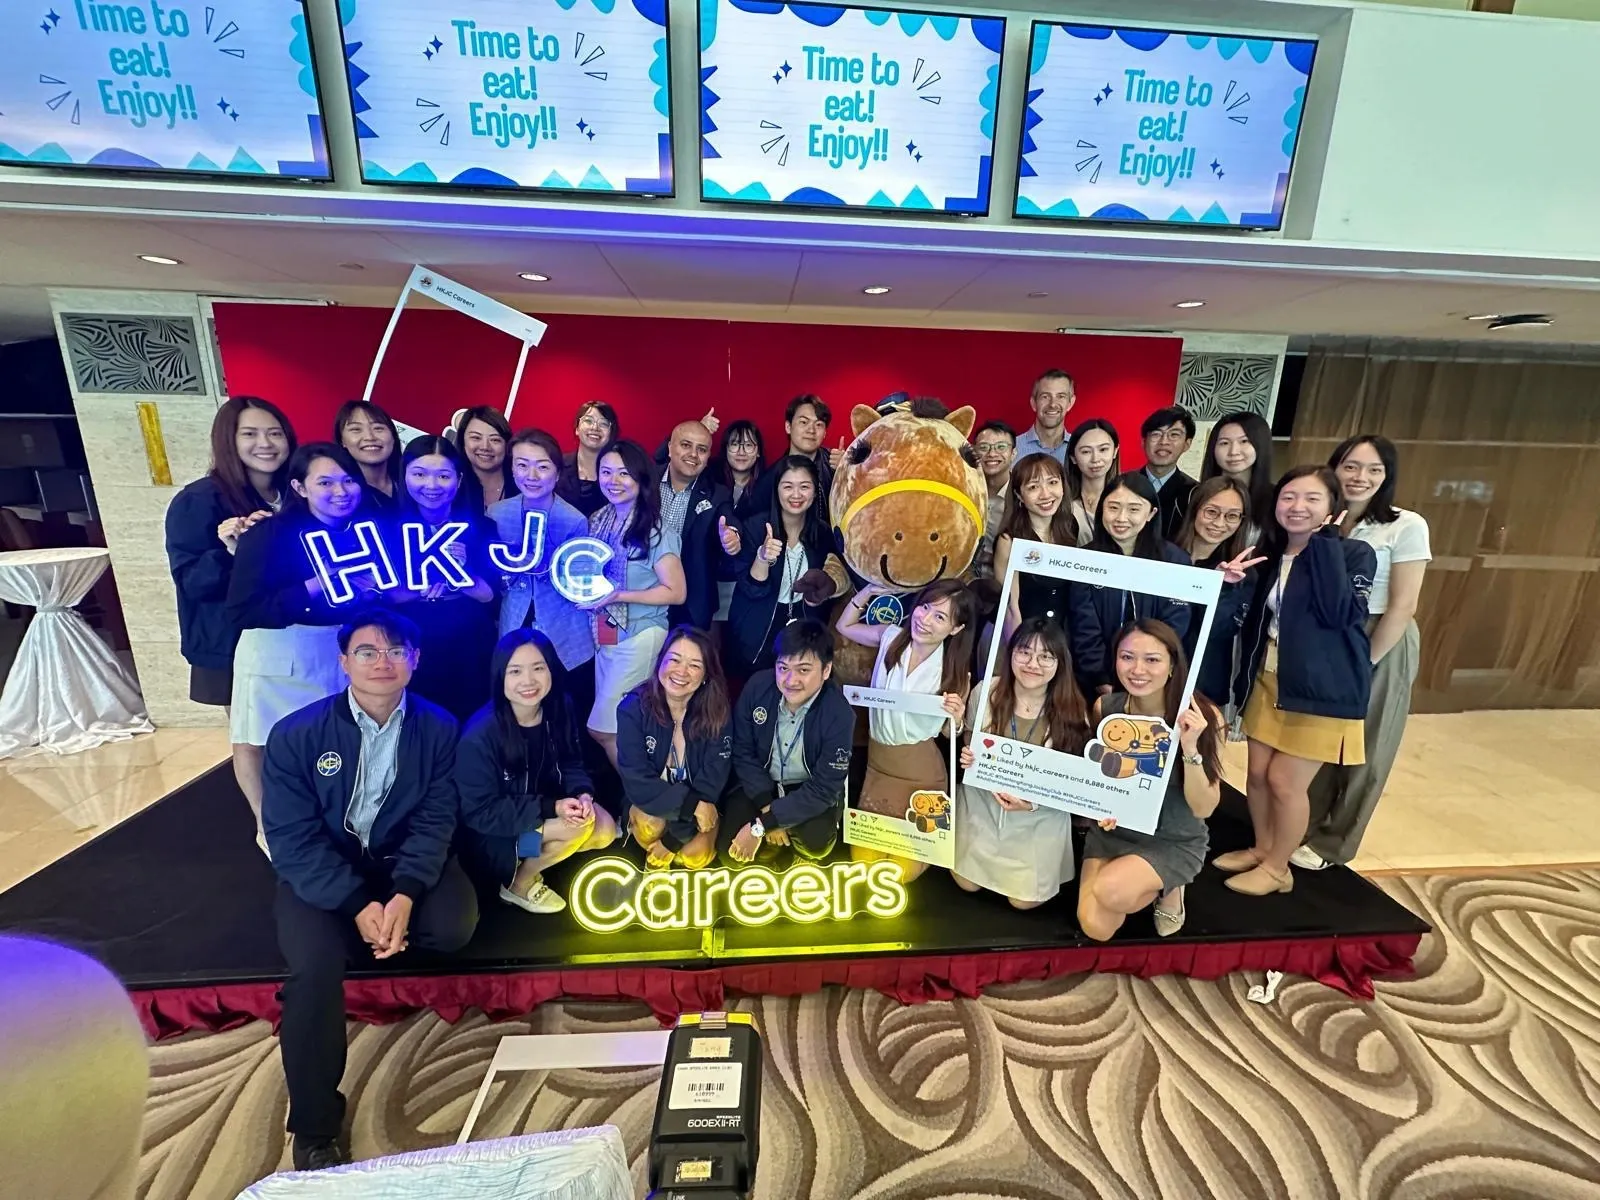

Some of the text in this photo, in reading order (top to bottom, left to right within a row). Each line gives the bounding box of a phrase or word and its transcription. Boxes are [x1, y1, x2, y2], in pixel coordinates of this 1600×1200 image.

[74, 0, 190, 38] Time to
[109, 41, 172, 78] eat!
[451, 20, 560, 62] Time to
[483, 66, 538, 101] eat!
[802, 46, 900, 87] Time to
[98, 79, 198, 129] Enjoy!!
[825, 90, 875, 123] eat!
[1124, 69, 1213, 108] Time to
[469, 102, 558, 149] Enjoy!!
[1138, 111, 1188, 143] eat!
[808, 125, 889, 170] Enjoy!!
[1118, 144, 1196, 188] Enjoy!!
[436, 286, 474, 307] HKJC Careers
[1048, 558, 1072, 568] HKJC
[1074, 562, 1108, 574] Careers
[978, 762, 1024, 778] HKJC Careers
[997, 756, 1013, 765] Liked
[1015, 760, 1024, 769] by
[1025, 764, 1069, 779] hkjc_careers
[1085, 780, 1104, 789] 8,888
[1106, 785, 1130, 795] others
[571, 858, 906, 932] Careers
